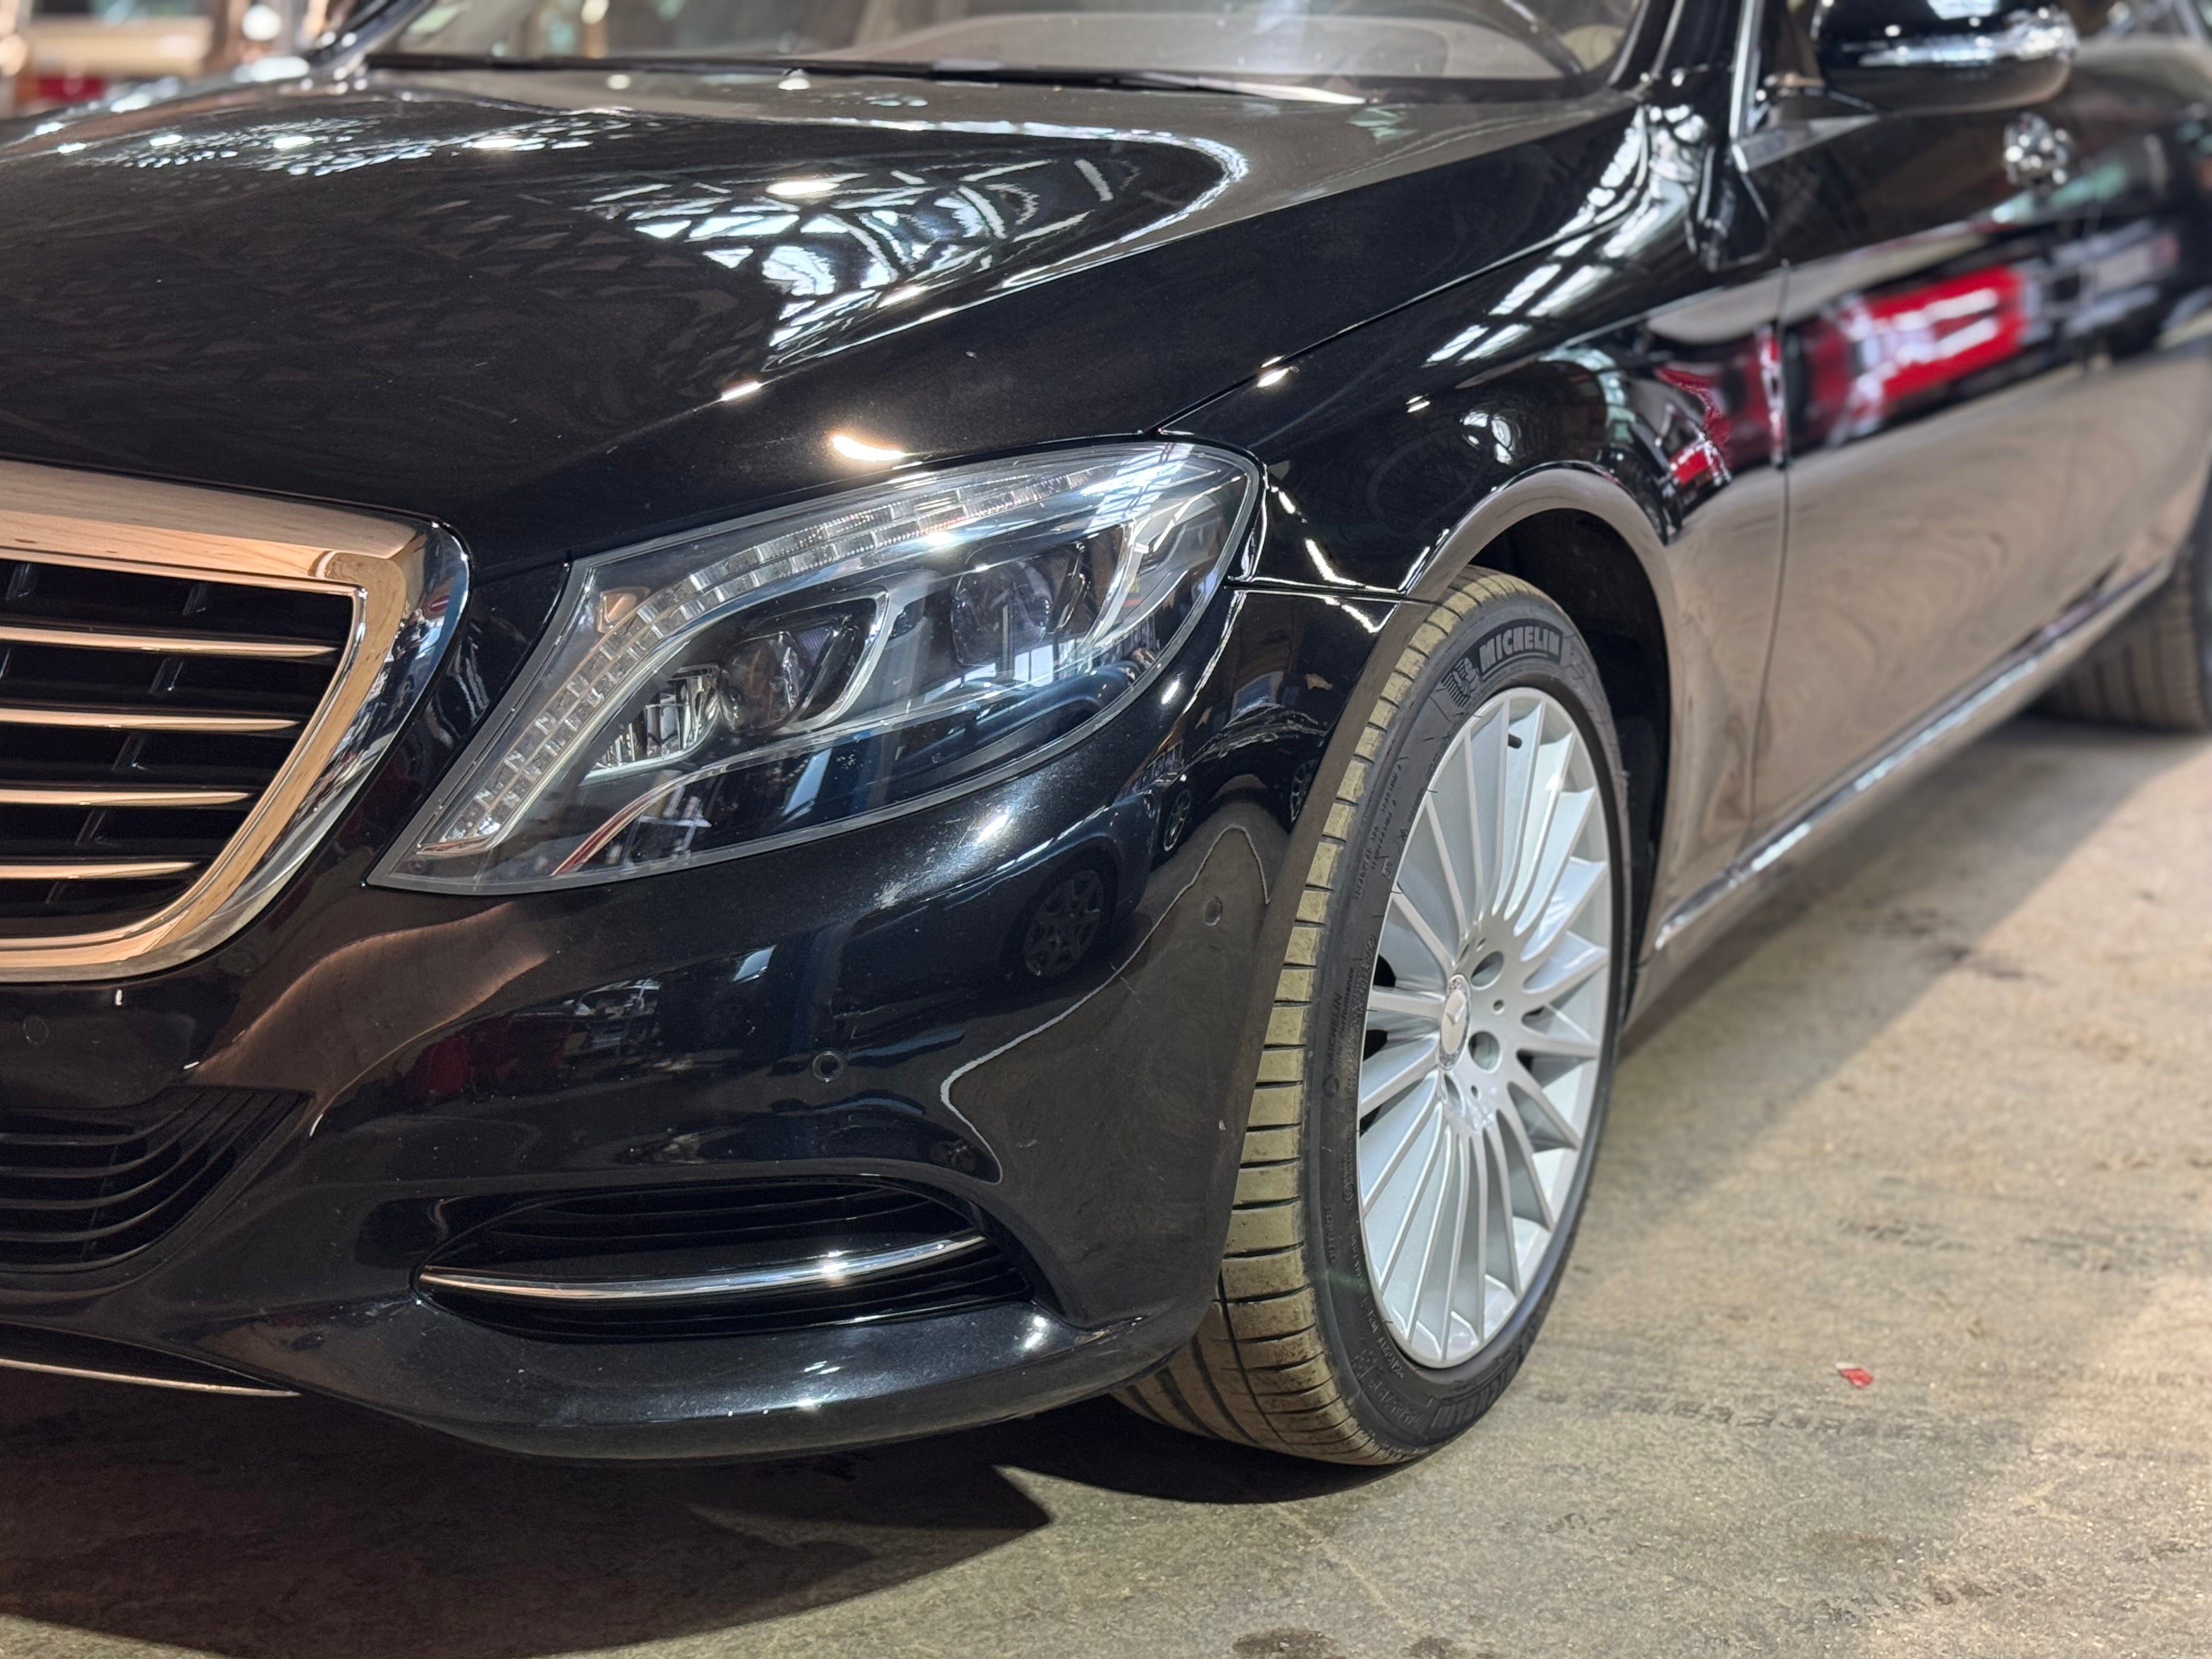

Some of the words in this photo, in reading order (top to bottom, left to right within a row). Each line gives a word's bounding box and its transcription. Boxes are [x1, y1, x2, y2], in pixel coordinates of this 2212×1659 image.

[1479, 626, 1560, 673] MICHELIN
[1327, 992, 1342, 1067] MICHELIN
[1339, 966, 1355, 1039] Performance
